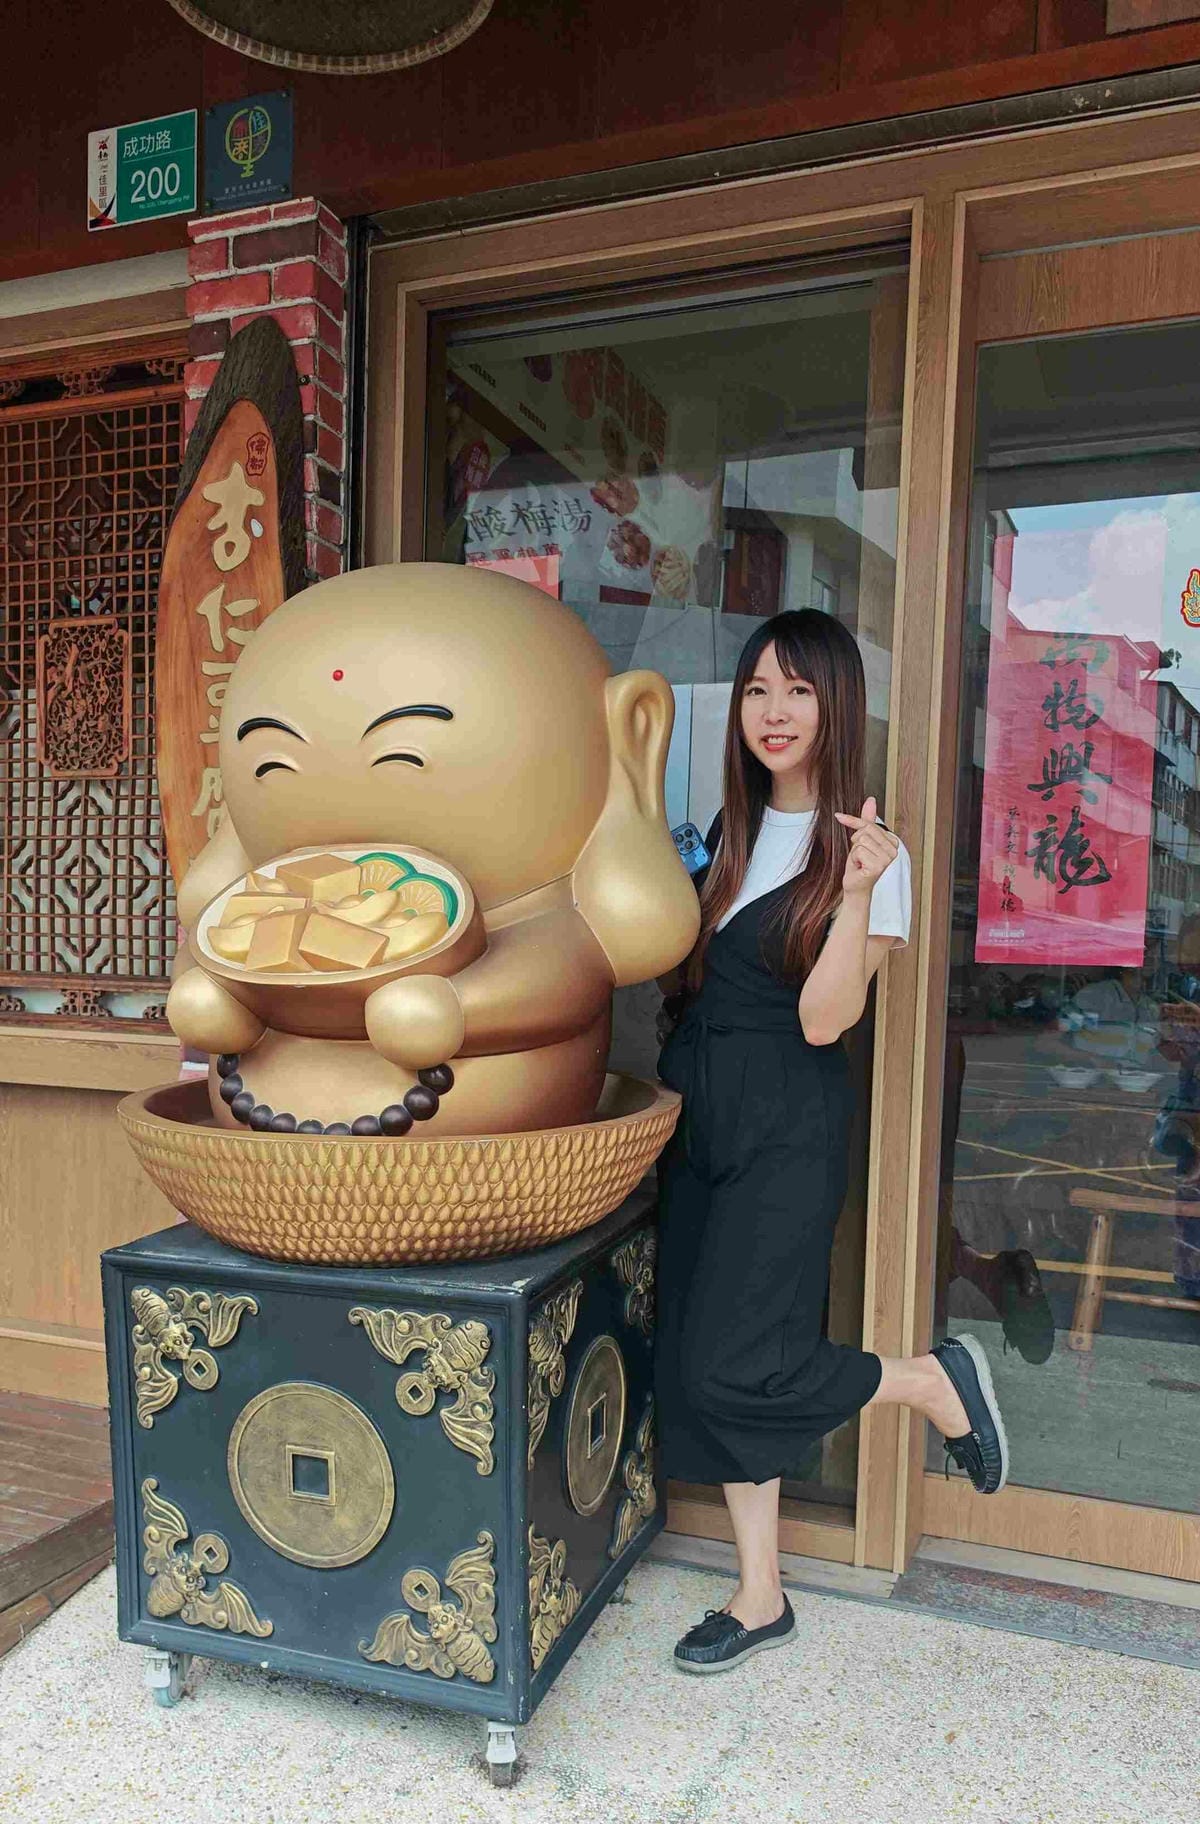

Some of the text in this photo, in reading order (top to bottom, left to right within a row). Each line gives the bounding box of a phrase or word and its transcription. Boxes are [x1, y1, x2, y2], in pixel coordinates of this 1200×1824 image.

[123, 130, 172, 158] 成功路
[130, 162, 181, 204] 200
[465, 497, 593, 543] 酸梅湯
